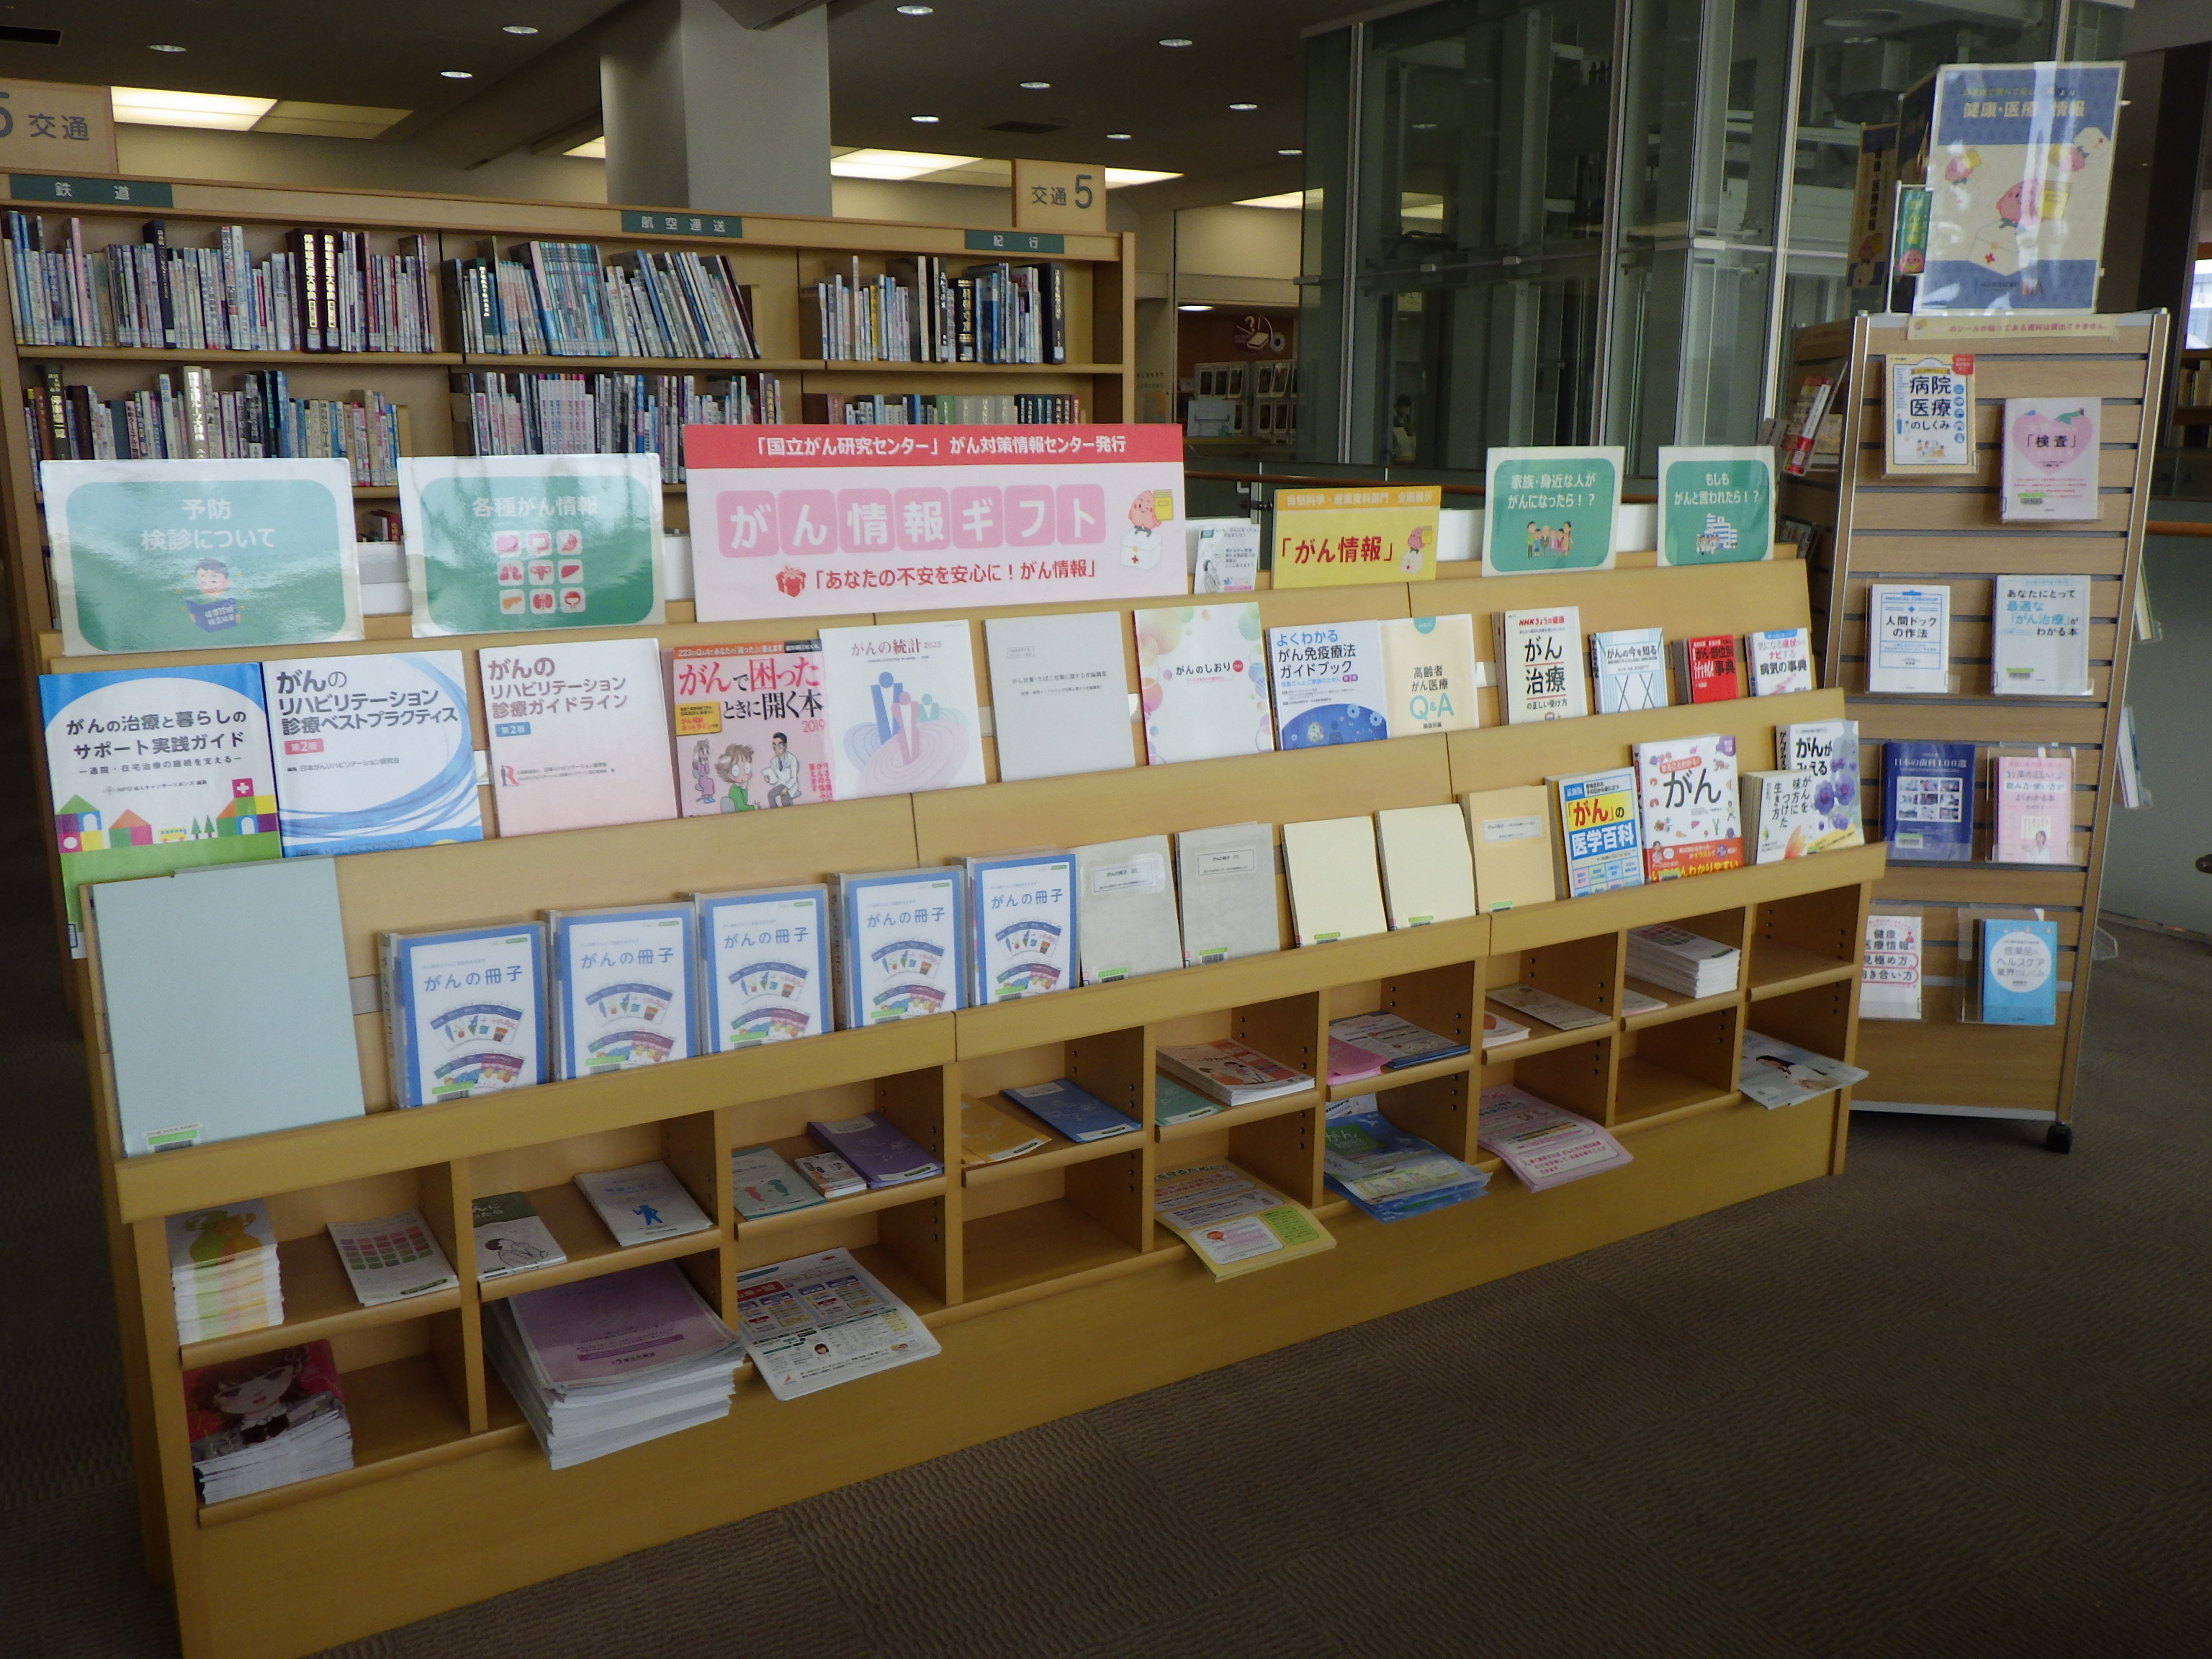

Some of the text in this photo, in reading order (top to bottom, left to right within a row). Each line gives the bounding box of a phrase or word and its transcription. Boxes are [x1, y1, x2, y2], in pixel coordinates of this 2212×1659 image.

[29, 113, 89, 140] 交通
[1030, 174, 1093, 209] 交通 5
[641, 216, 725, 233] 航空運送
[1910, 376, 1951, 395] 病院
[1910, 398, 1951, 416] 医療
[1910, 421, 1950, 431] のしくみ
[756, 434, 1127, 457] 「国立がん研究センター」 がん対策情報センター発行
[2027, 433, 2076, 448] 「検査」
[1511, 473, 1596, 489] 家族・身近な人が
[1706, 473, 1729, 486] もしも
[181, 498, 232, 521] 予防
[472, 494, 599, 518] 各種がん情報
[729, 494, 1096, 551] がん情報ギフト
[141, 527, 275, 552] 検診について
[1280, 535, 1393, 565] 「がん情報」
[814, 561, 1097, 591] 「あなたの不安を安心に！がん情報」
[2007, 590, 2076, 598] あなたにとって
[2007, 601, 2044, 611] 最適な
[1885, 616, 1938, 626] 人間ドック
[1277, 629, 1339, 647] よくわかる
[1892, 628, 1928, 639] の作法
[2036, 628, 2080, 637] わかる本
[850, 638, 920, 657] がんの統計
[1278, 643, 1357, 663] がん免疫療法
[1524, 636, 1563, 662] がん
[1606, 645, 1658, 660] がんの今を知る
[487, 657, 555, 681] がんの
[679, 656, 820, 696] がんで困った
[1176, 662, 1231, 675] がんのしおり
[1280, 660, 1352, 679] ガイドブック
[1413, 665, 1444, 678] 高齢者
[1760, 660, 1807, 675] 病気の事典
[276, 669, 347, 694] がんの
[490, 677, 626, 699] リハビリテーション
[1411, 678, 1449, 692] がん医療
[1526, 665, 1566, 695] 治療
[279, 689, 439, 716] リハビリテーション
[492, 695, 628, 719] 診療ガイドライン
[723, 689, 824, 720] ときに開く本
[1409, 693, 1455, 721] Q&A
[1527, 699, 1568, 710] の正しい受け方
[66, 709, 247, 736] がんの治療と暮らしの
[282, 706, 459, 736] 診療ベストプラクティス
[801, 720, 825, 733] 2019
[73, 732, 244, 760] サポート実践ガイド
[1796, 737, 1832, 759] がんが
[1663, 768, 1722, 808] がん
[1568, 798, 1624, 827] 「がん」の
[1571, 822, 1635, 857] 医学百科
[991, 888, 1064, 910] がんの冊子
[867, 907, 945, 928] がんの冊子
[724, 927, 809, 949] がんの冊子
[580, 948, 674, 969] がんの冊子
[1996, 957, 2045, 967] ヘルスケア
[423, 965, 523, 992] がんの冊子
